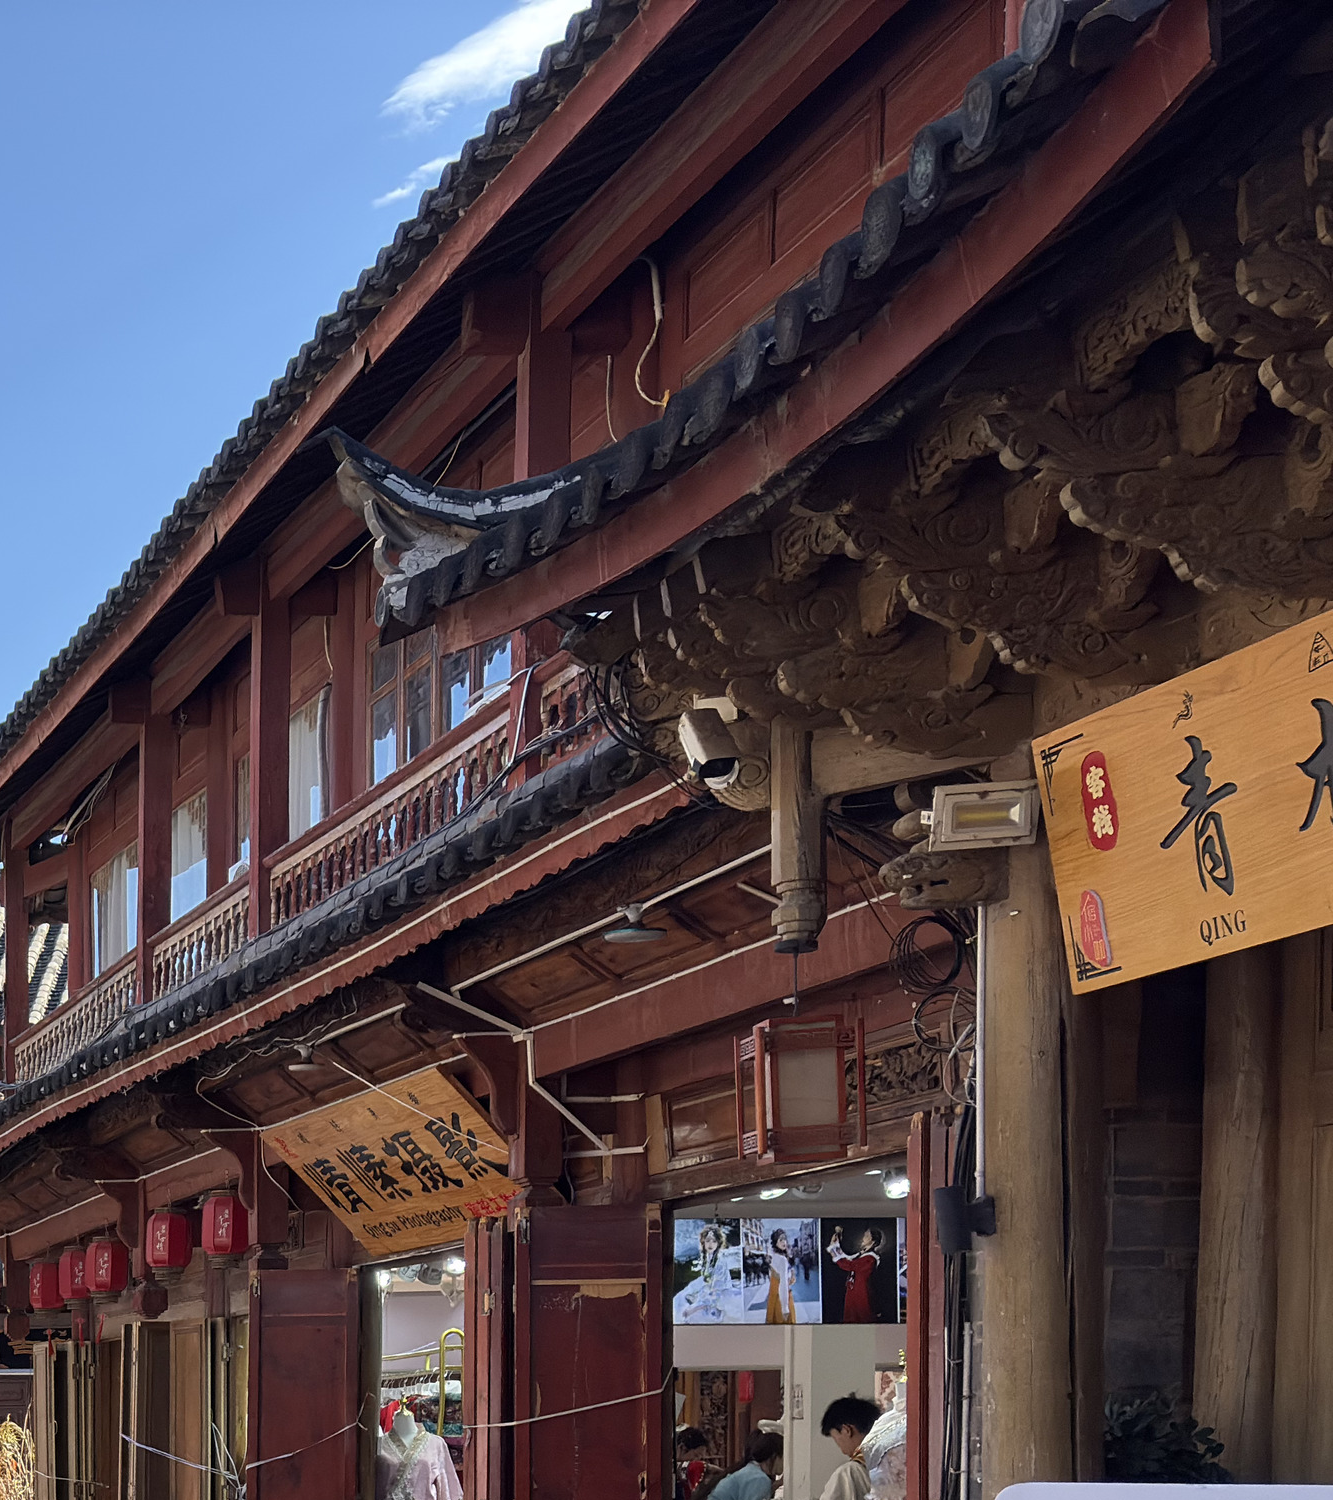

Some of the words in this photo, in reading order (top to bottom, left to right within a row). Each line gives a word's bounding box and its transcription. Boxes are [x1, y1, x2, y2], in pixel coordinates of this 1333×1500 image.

[1085, 765, 1114, 839] 客栈
[1199, 909, 1247, 947] QING
[402, 1203, 467, 1231] Photography
